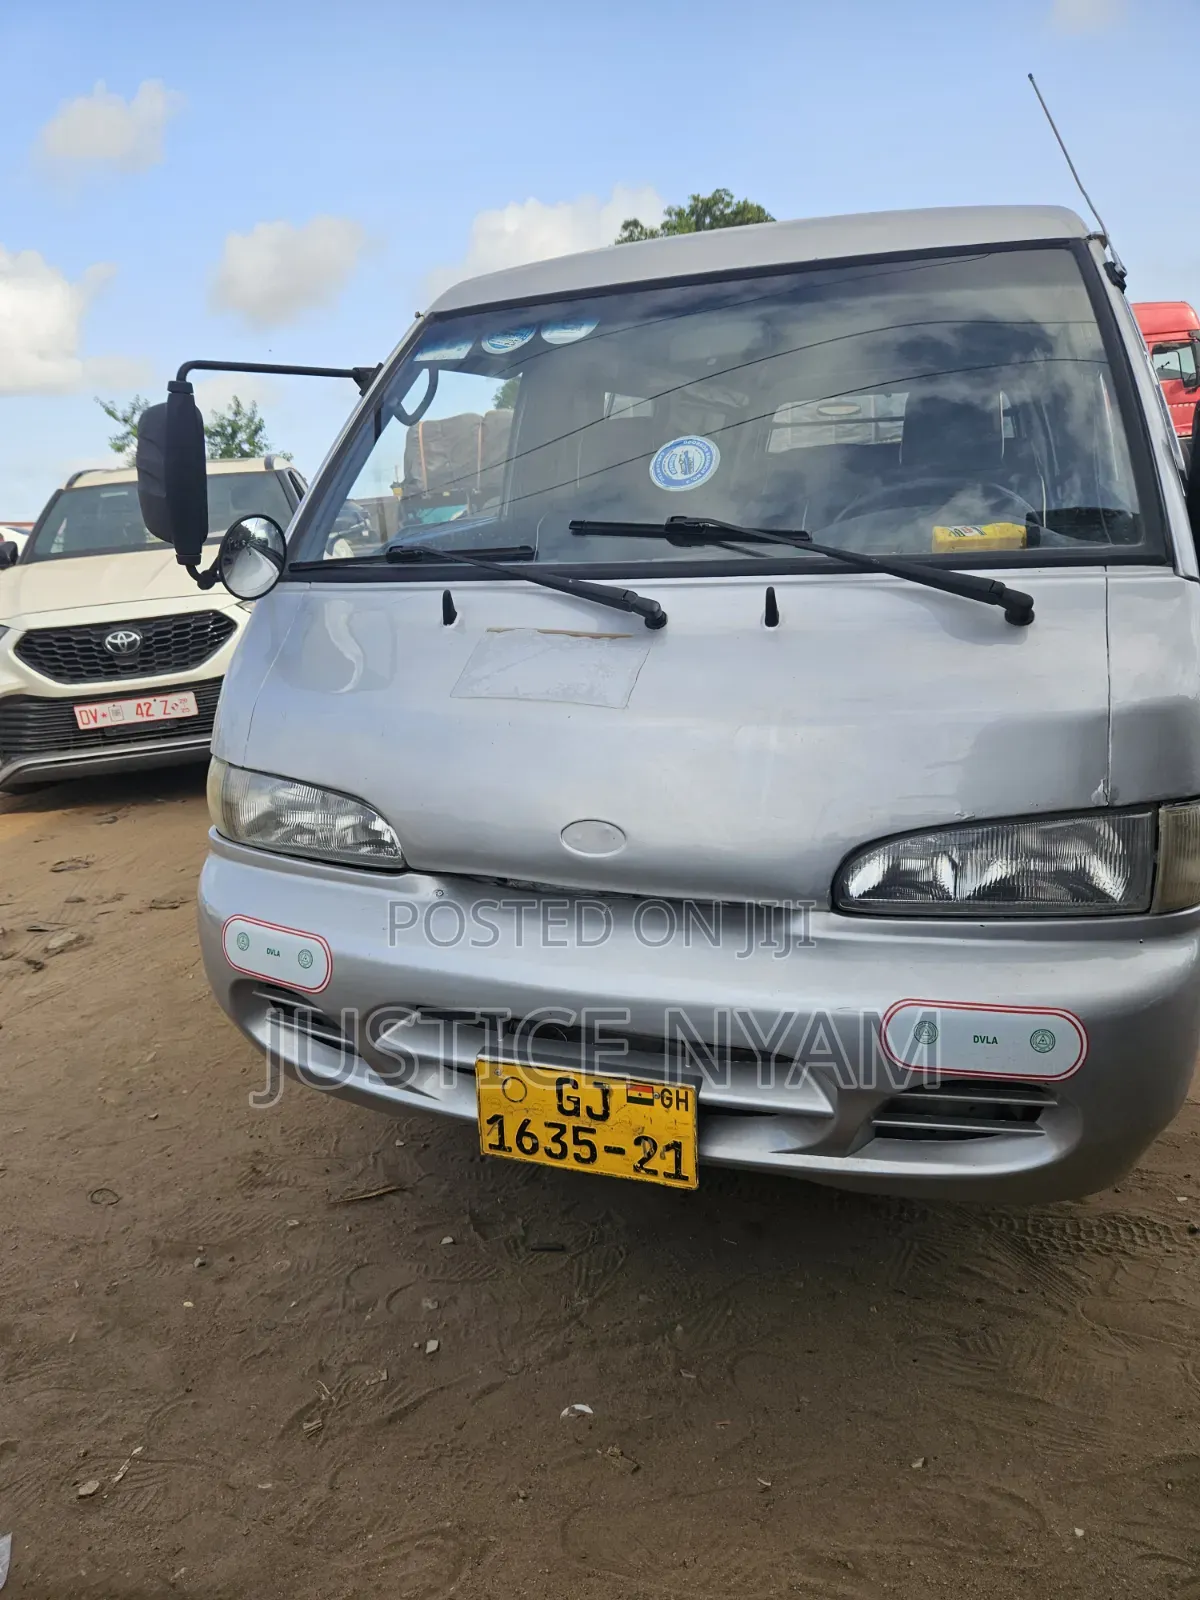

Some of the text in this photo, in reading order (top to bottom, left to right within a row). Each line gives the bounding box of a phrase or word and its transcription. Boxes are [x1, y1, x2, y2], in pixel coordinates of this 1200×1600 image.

[266, 948, 280, 957] DVLA
[973, 1035, 998, 1045] DVLA
[555, 1077, 689, 1122] GJ GH
[486, 1114, 689, 1181] 1635-21
